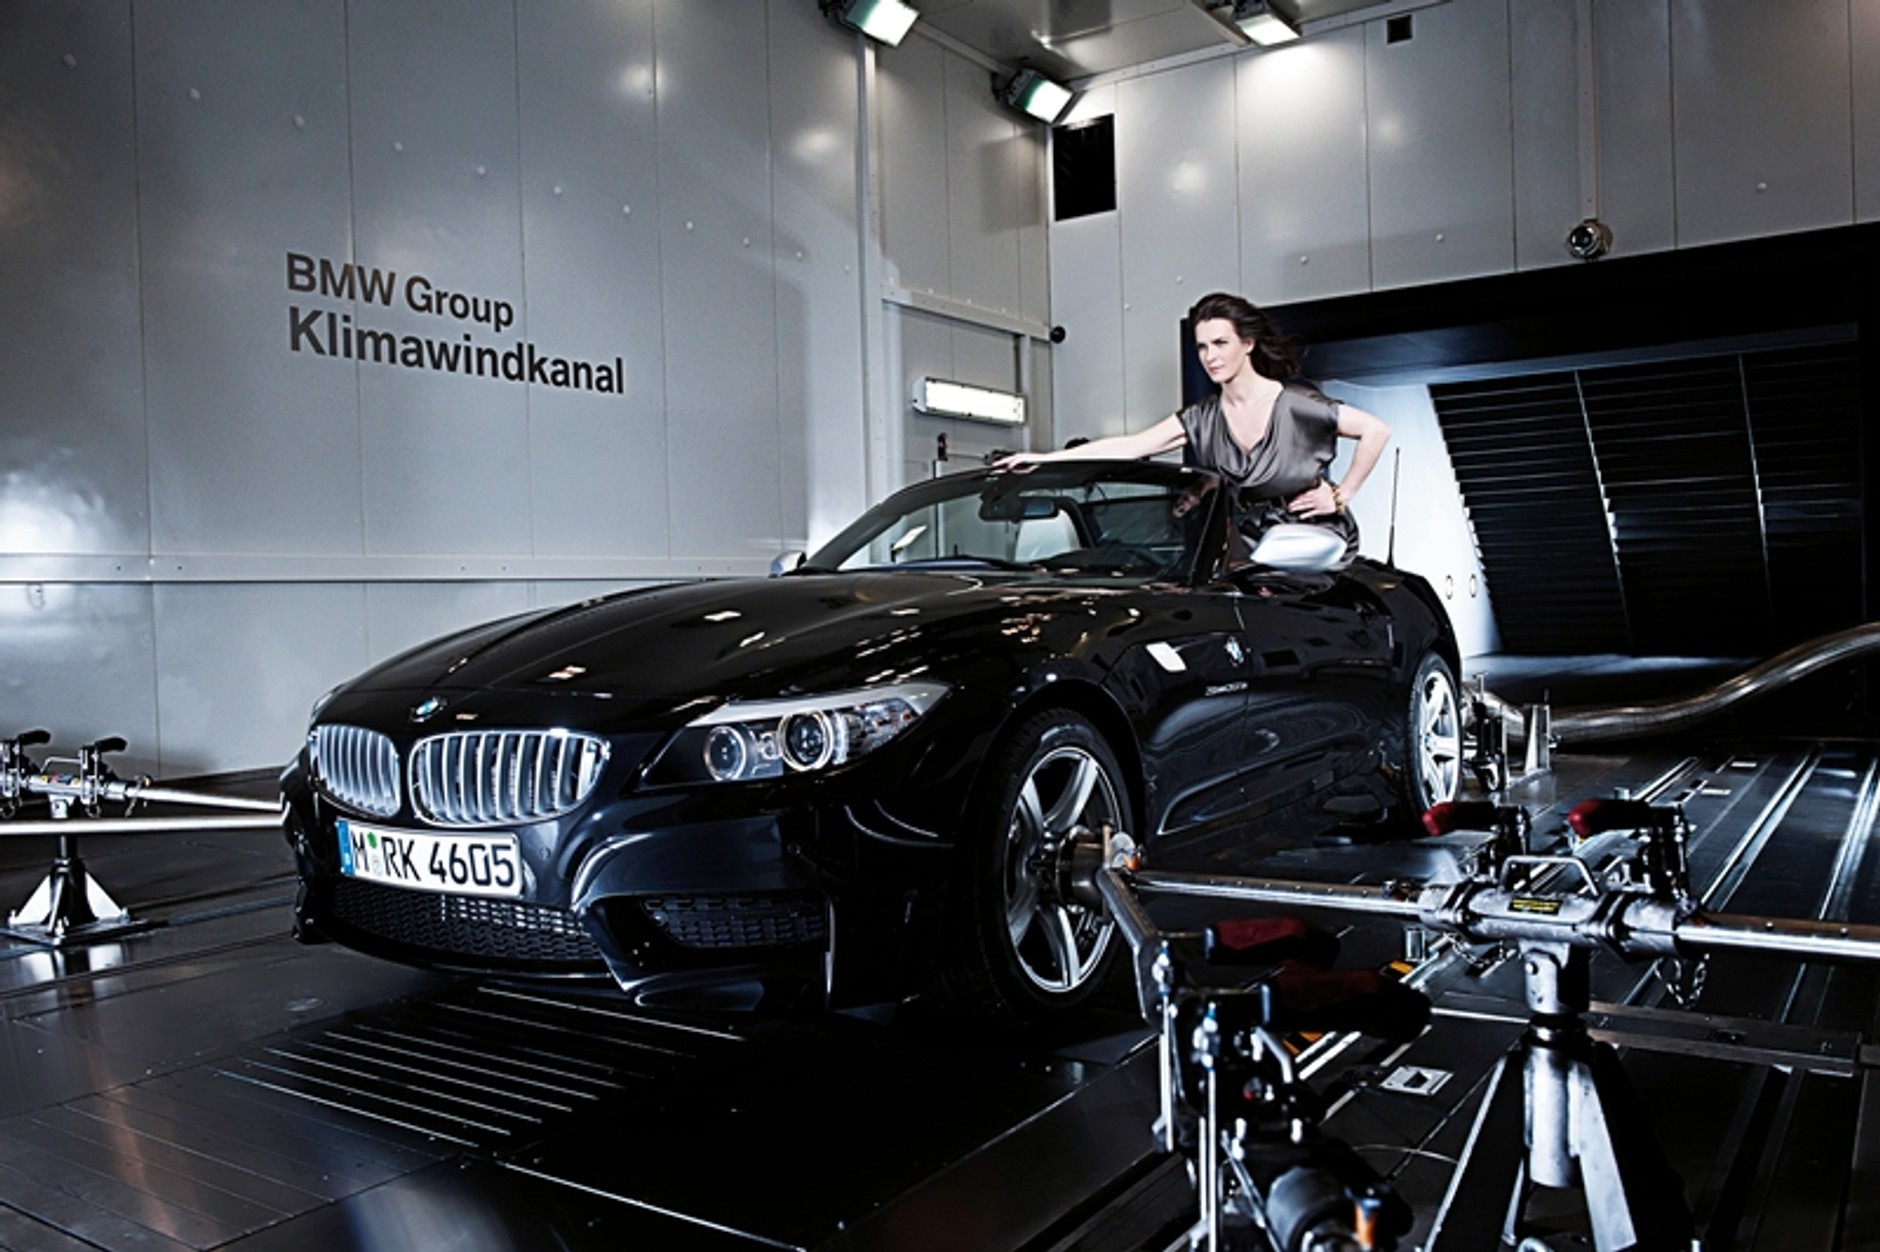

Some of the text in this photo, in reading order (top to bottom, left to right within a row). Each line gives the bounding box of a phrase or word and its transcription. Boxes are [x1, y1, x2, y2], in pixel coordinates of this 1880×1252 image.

[286, 252, 515, 333] BMW Group
[289, 305, 625, 395] Klimawindkanal
[351, 830, 514, 888] M RK 4605
